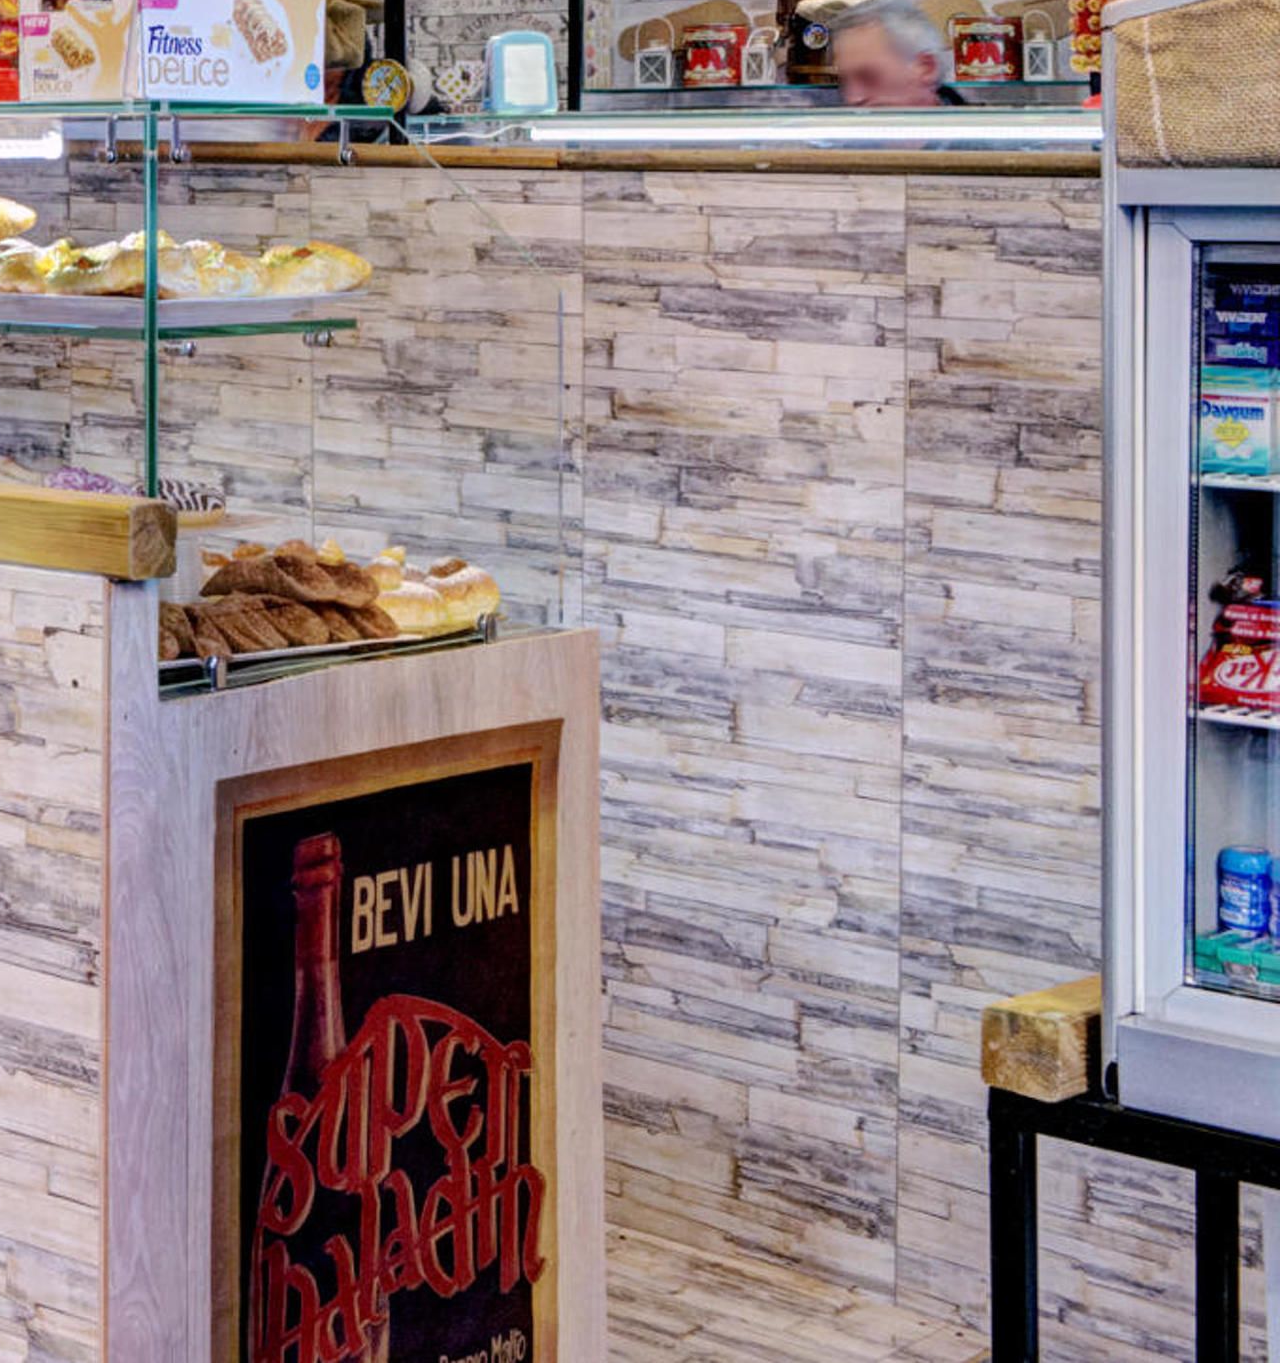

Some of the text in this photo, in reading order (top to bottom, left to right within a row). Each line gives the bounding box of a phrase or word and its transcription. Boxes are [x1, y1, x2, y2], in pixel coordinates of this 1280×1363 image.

[147, 24, 203, 55] Fitness
[1201, 400, 1265, 421] Daygum
[351, 844, 520, 955] BEVI UNA
